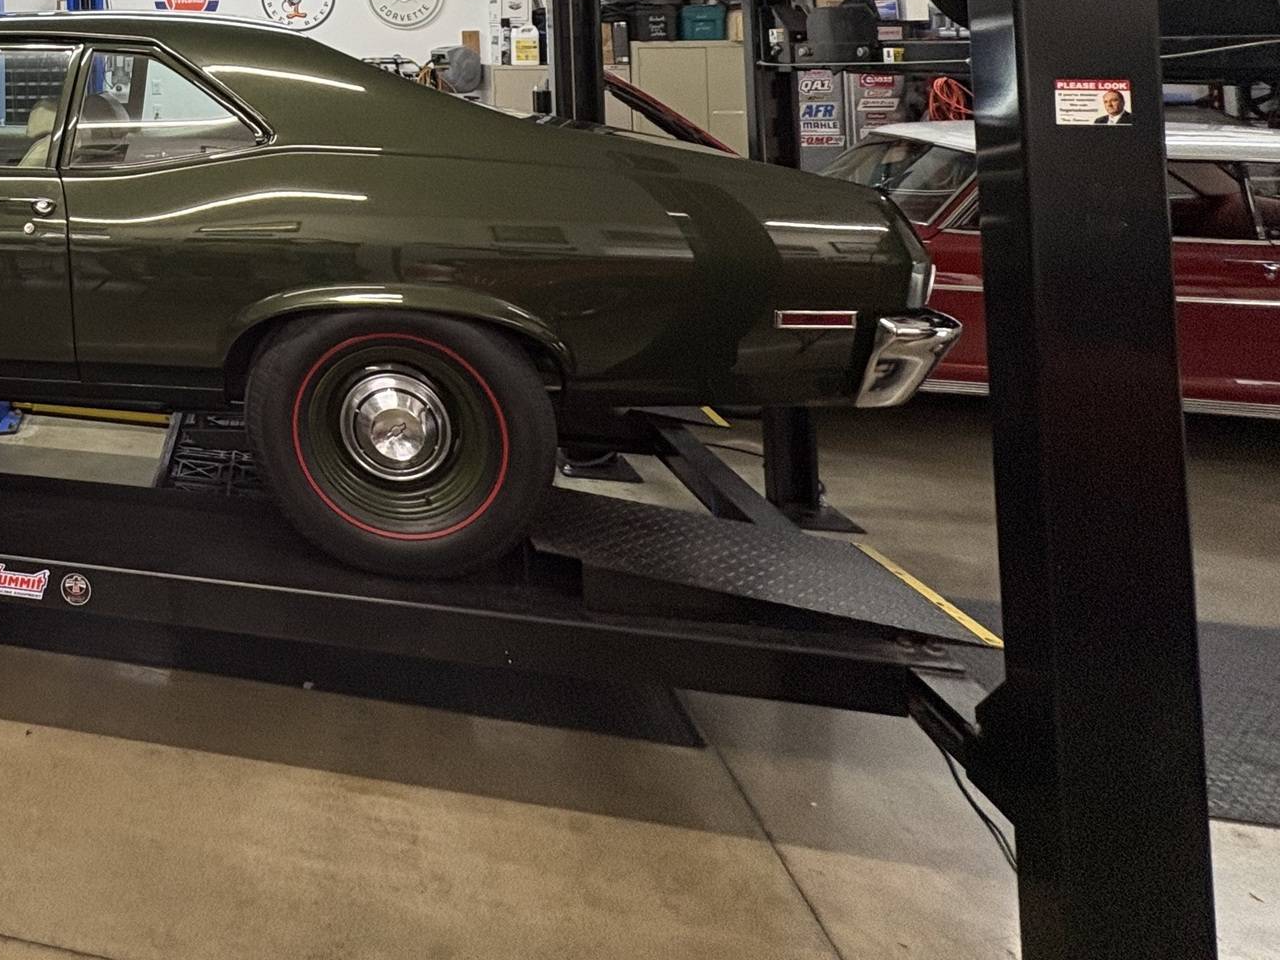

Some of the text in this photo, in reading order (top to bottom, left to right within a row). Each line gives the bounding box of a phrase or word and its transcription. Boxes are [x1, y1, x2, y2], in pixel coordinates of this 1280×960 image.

[379, 3, 430, 22] CORVETTE
[801, 79, 831, 93] QA1
[1098, 82, 1128, 90] LOOK
[802, 104, 835, 118] AFR
[802, 121, 838, 129] MAHLE
